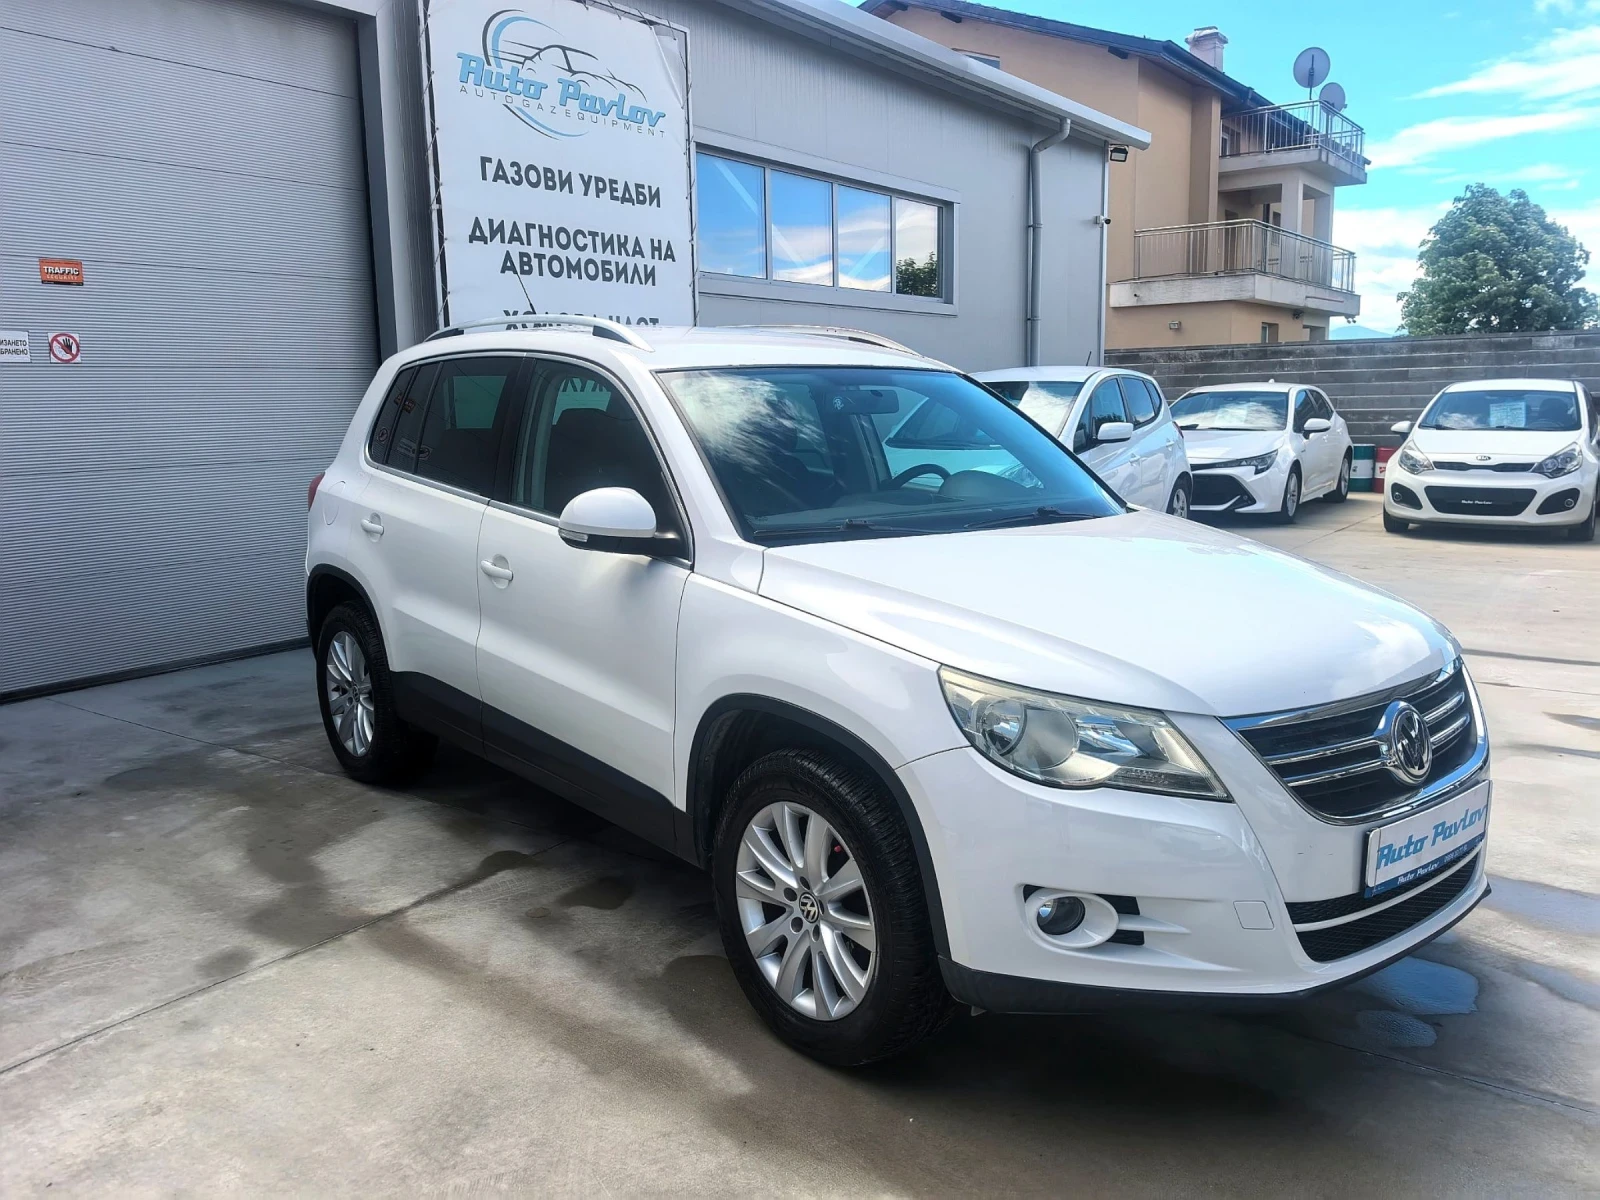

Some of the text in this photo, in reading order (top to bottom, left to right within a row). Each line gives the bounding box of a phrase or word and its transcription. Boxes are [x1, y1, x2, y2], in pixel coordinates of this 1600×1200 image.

[456, 52, 548, 100] Auto
[480, 155, 661, 208] ГАЗОВИ УРЕДБИ
[468, 216, 676, 262] ДИАГНОСТИКА НА
[43, 266, 79, 275] TRAFFIC
[500, 250, 656, 286] АВТОМОБИЛИ
[1376, 834, 1429, 869] Auto
